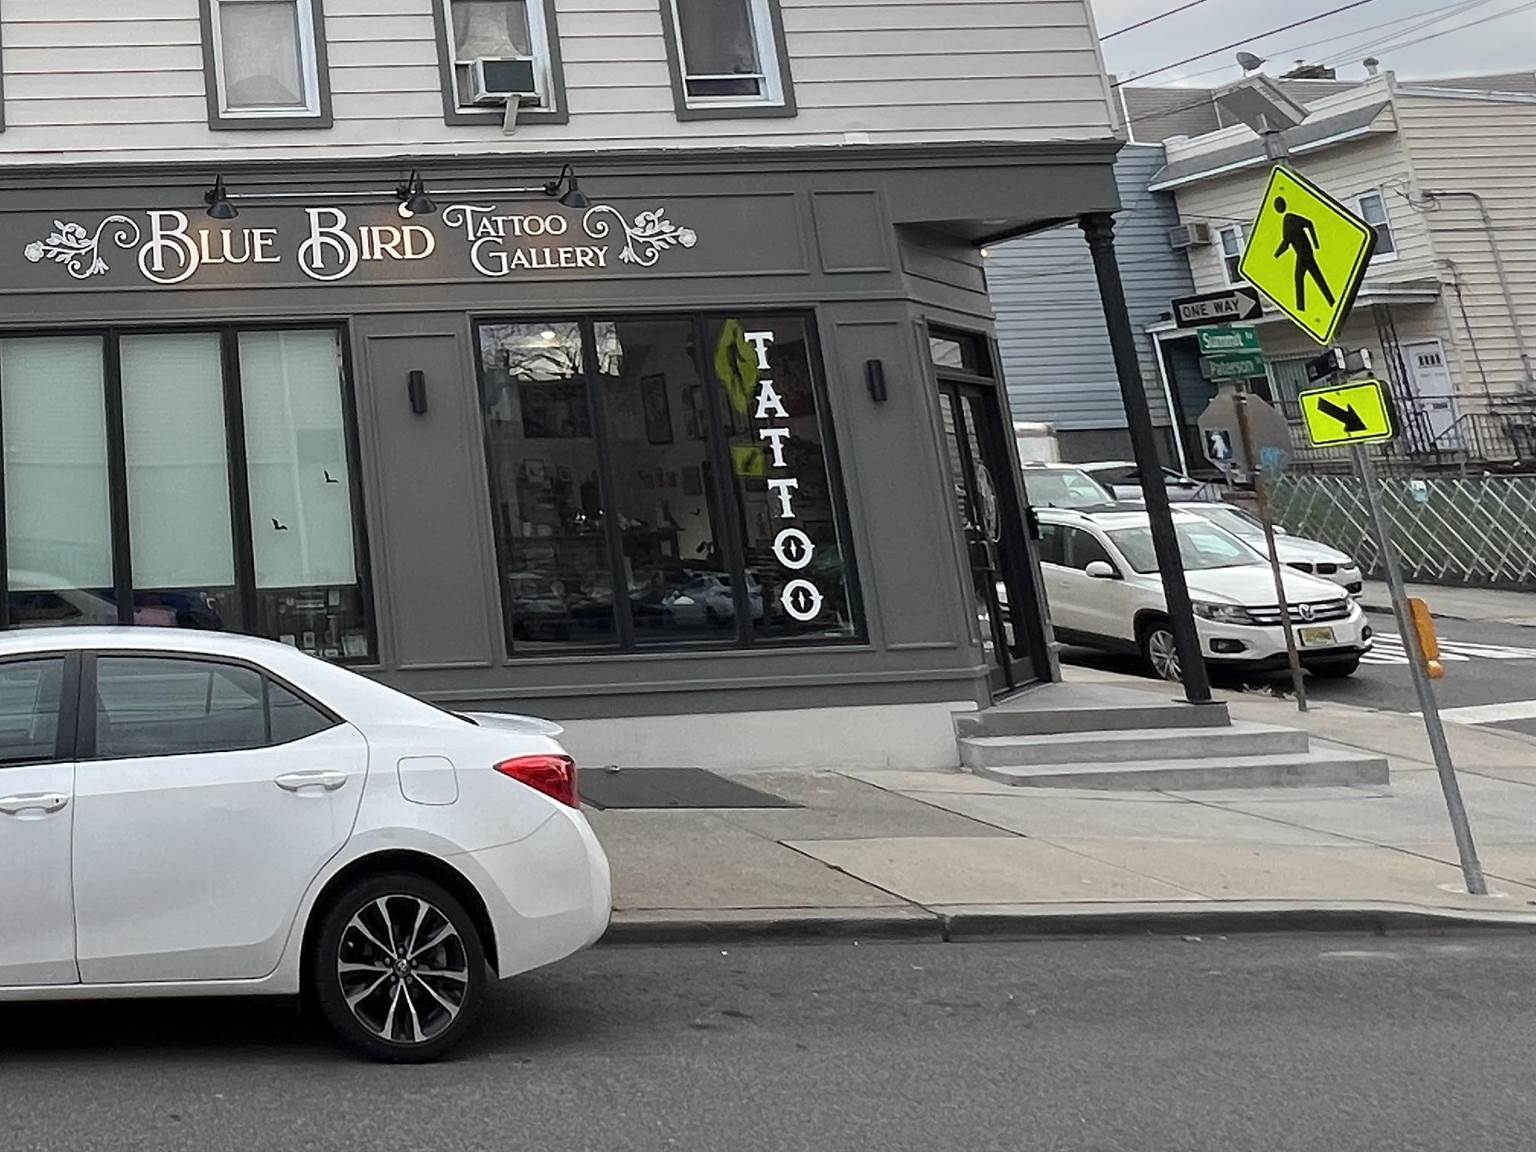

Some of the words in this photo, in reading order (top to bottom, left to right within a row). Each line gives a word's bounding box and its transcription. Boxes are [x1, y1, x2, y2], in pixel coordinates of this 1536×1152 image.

[443, 204, 567, 240] TATTOO
[137, 209, 281, 284] BLUE
[297, 207, 435, 281] BIRD
[470, 236, 608, 277] GALLERY
[1183, 303, 1209, 318] ONE
[1213, 299, 1239, 313] WAY
[744, 331, 823, 621] TATTOO
